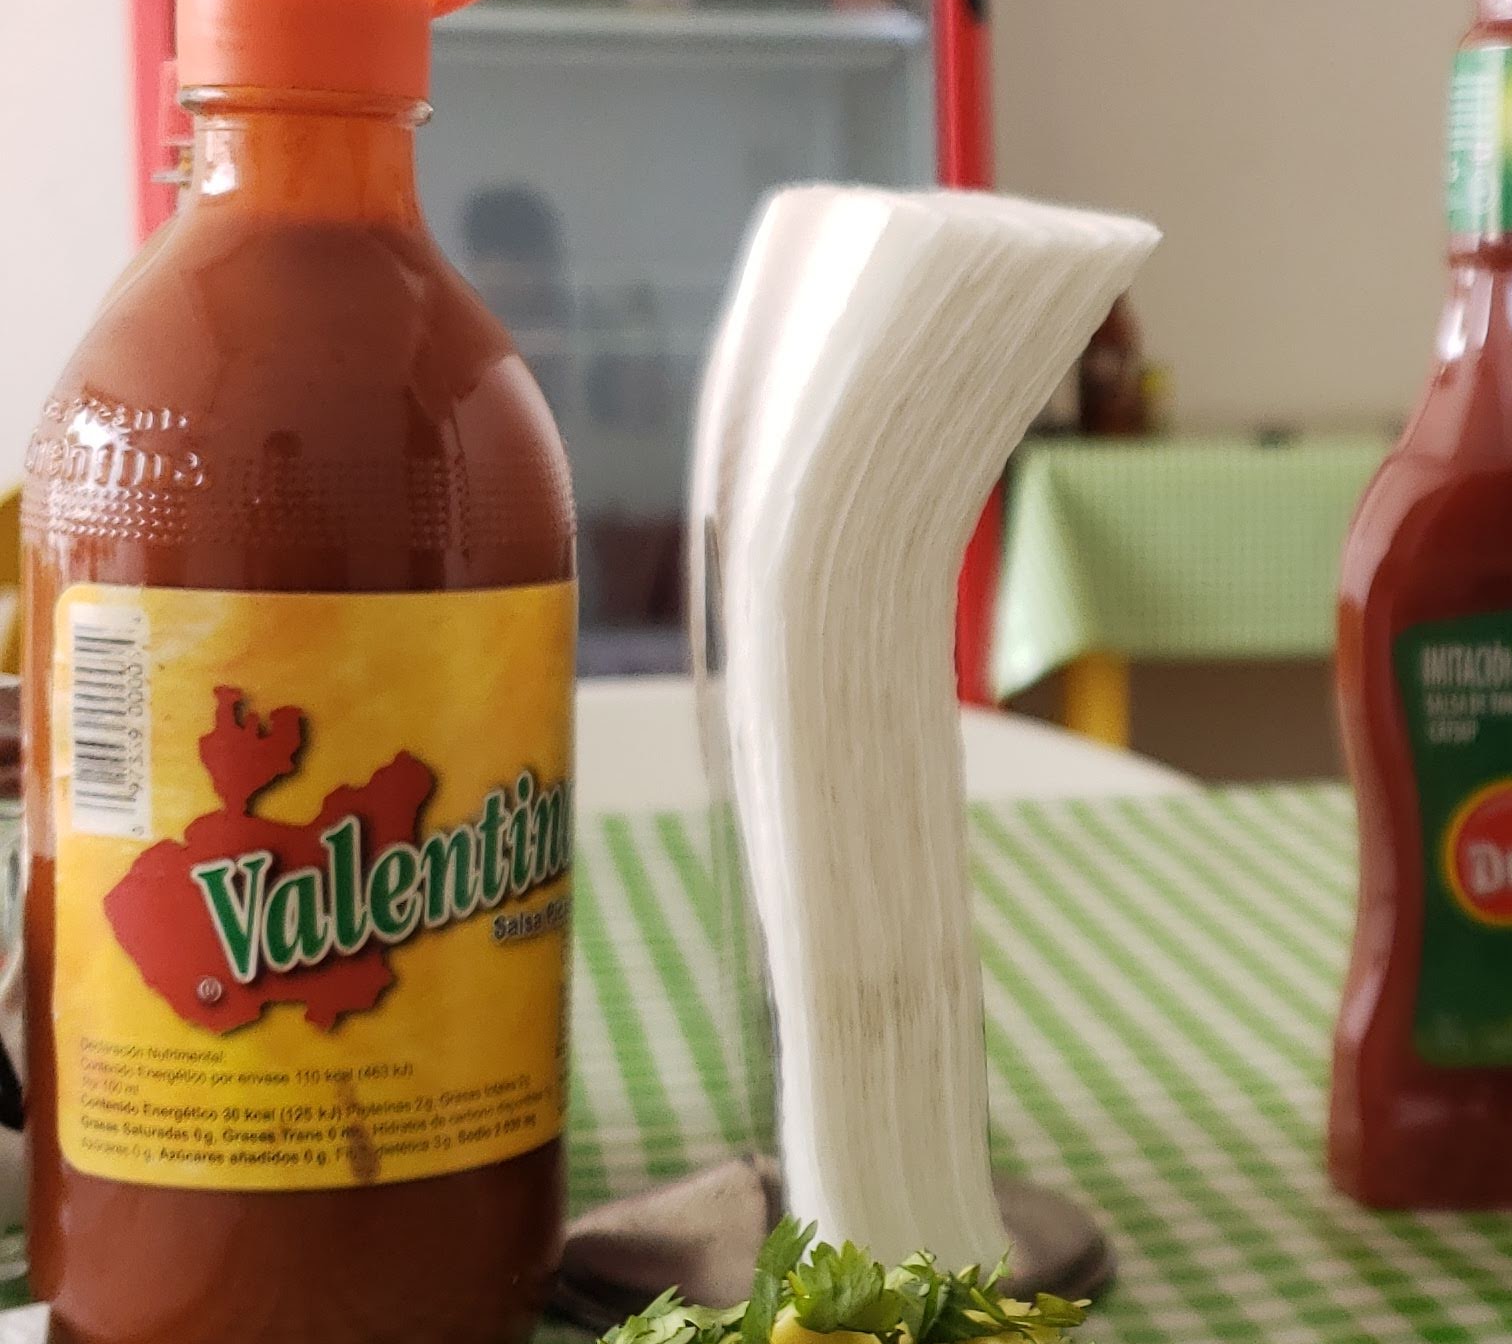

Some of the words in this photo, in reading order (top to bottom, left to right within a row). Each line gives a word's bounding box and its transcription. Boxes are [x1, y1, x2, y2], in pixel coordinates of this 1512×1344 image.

[238, 1071, 290, 1085] envase
[295, 1068, 320, 1084] 110
[80, 1094, 139, 1114] Contenido
[143, 1101, 218, 1123] Energético
[80, 1116, 117, 1133] Grasas
[123, 1122, 188, 1142] Saturadas
[222, 1127, 276, 1143] Grasas
[281, 1126, 322, 1143] Trans
